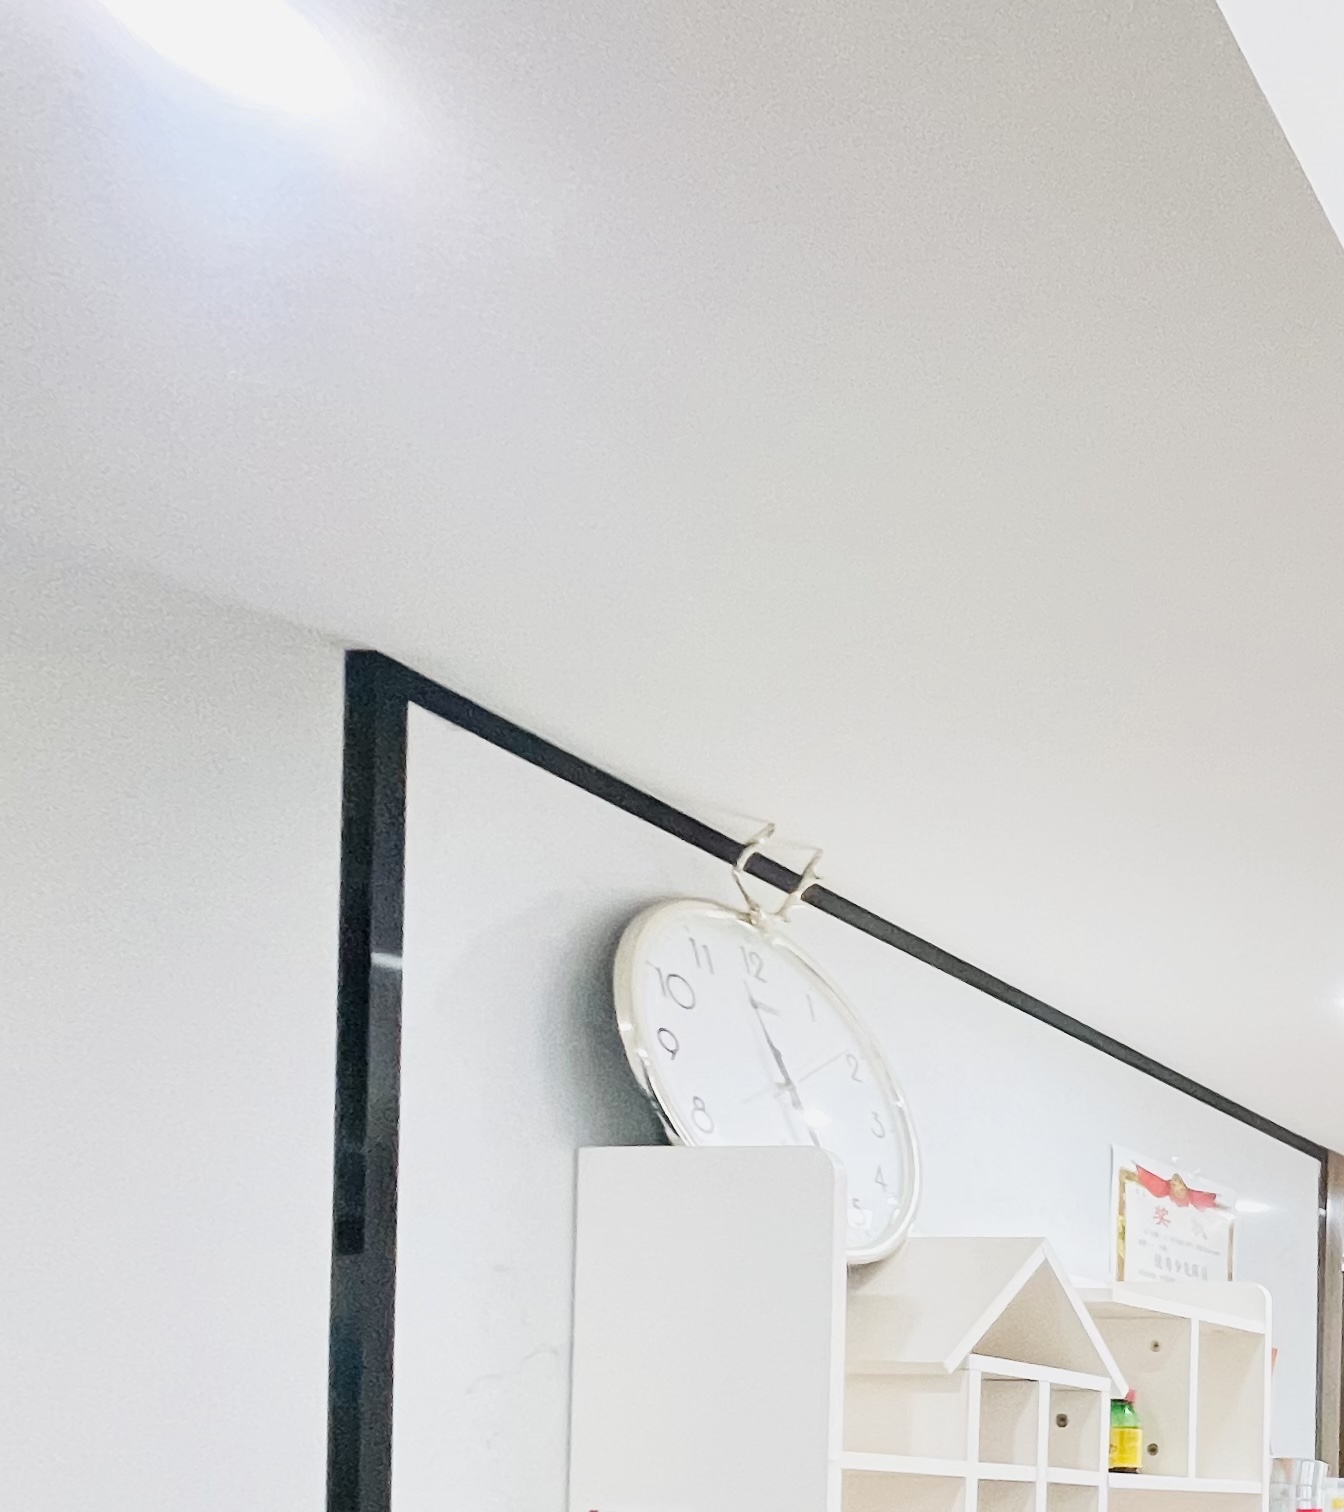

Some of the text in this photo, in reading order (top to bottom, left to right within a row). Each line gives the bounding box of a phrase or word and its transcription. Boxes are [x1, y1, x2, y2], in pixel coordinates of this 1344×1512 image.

[689, 937, 715, 975] 11
[739, 945, 768, 984] 12
[654, 963, 697, 1010] 10
[804, 992, 816, 1023] 1
[656, 1026, 680, 1061] 9
[845, 1053, 864, 1083] 2
[690, 1095, 715, 1134] 8
[870, 1110, 886, 1139] 3
[873, 1164, 888, 1192] 4
